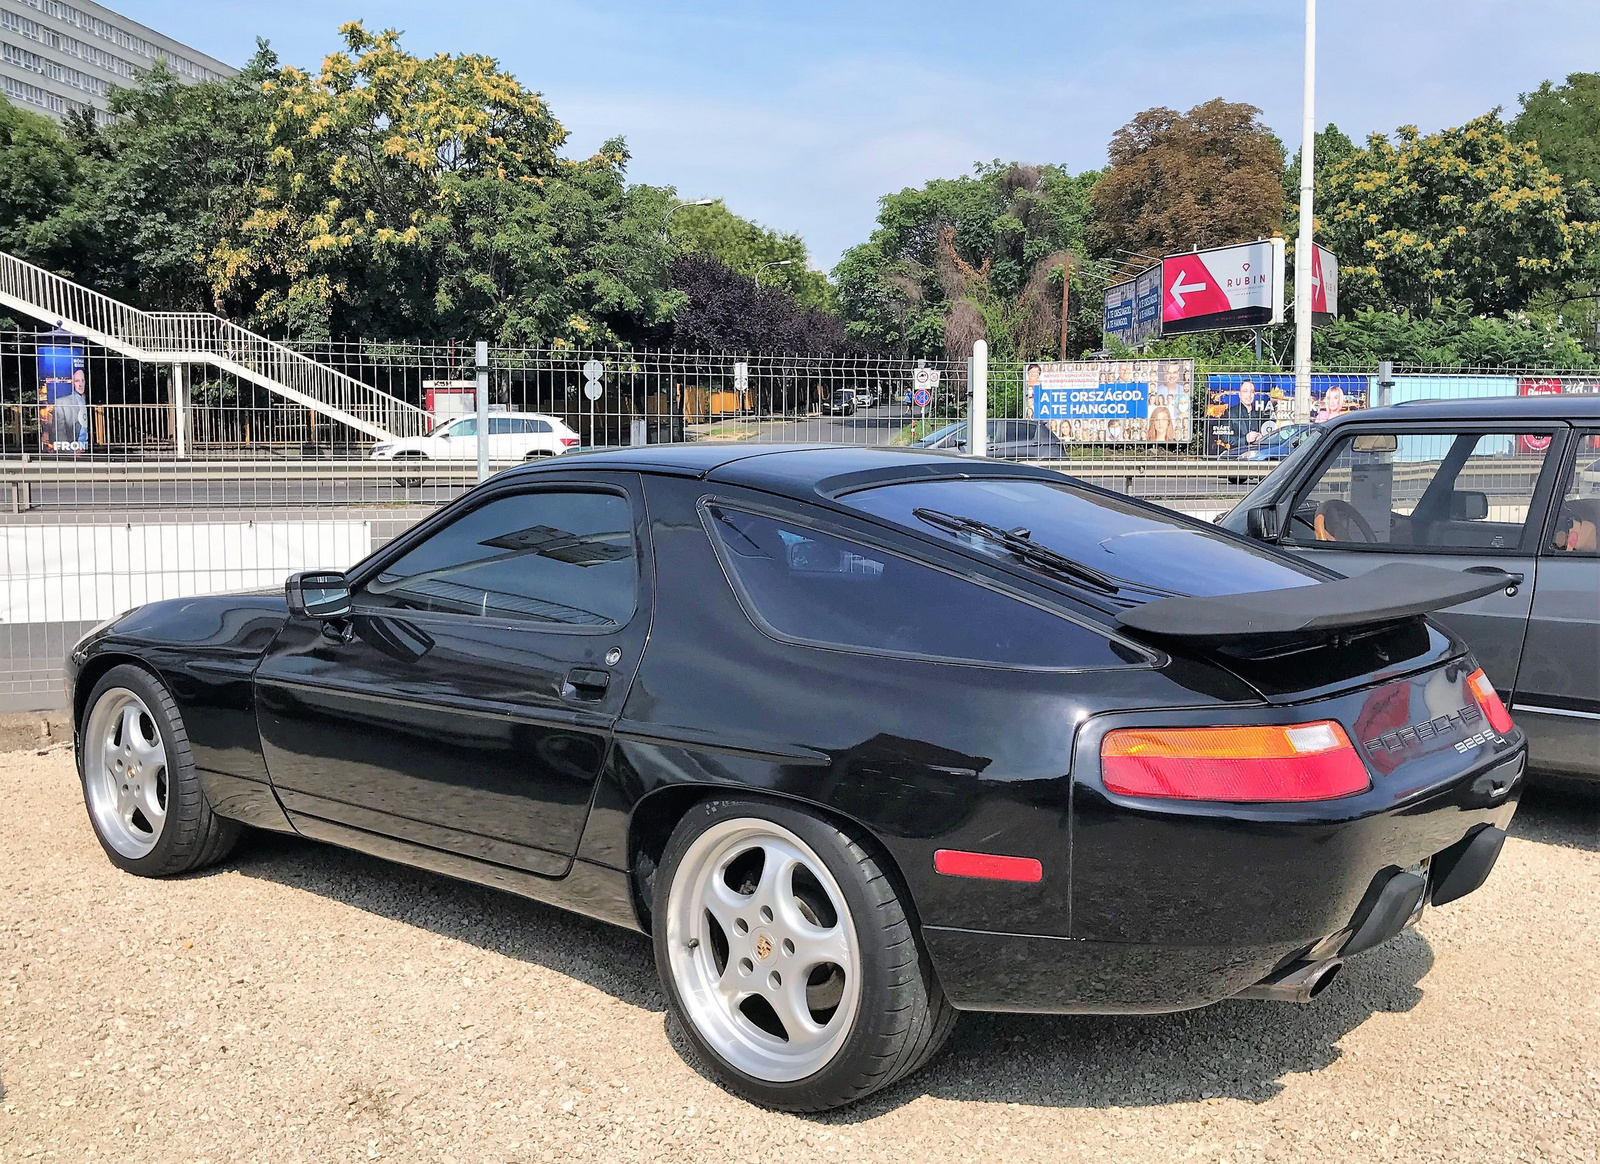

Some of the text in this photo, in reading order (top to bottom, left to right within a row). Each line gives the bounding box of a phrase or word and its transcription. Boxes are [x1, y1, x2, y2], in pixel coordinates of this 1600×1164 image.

[1227, 274, 1266, 288] RUBIN
[1040, 388, 1144, 402] A TE ORSZÁGOD.
[1040, 403, 1130, 415] A TE HANGOD.
[1363, 703, 1483, 759] PORSCHE
